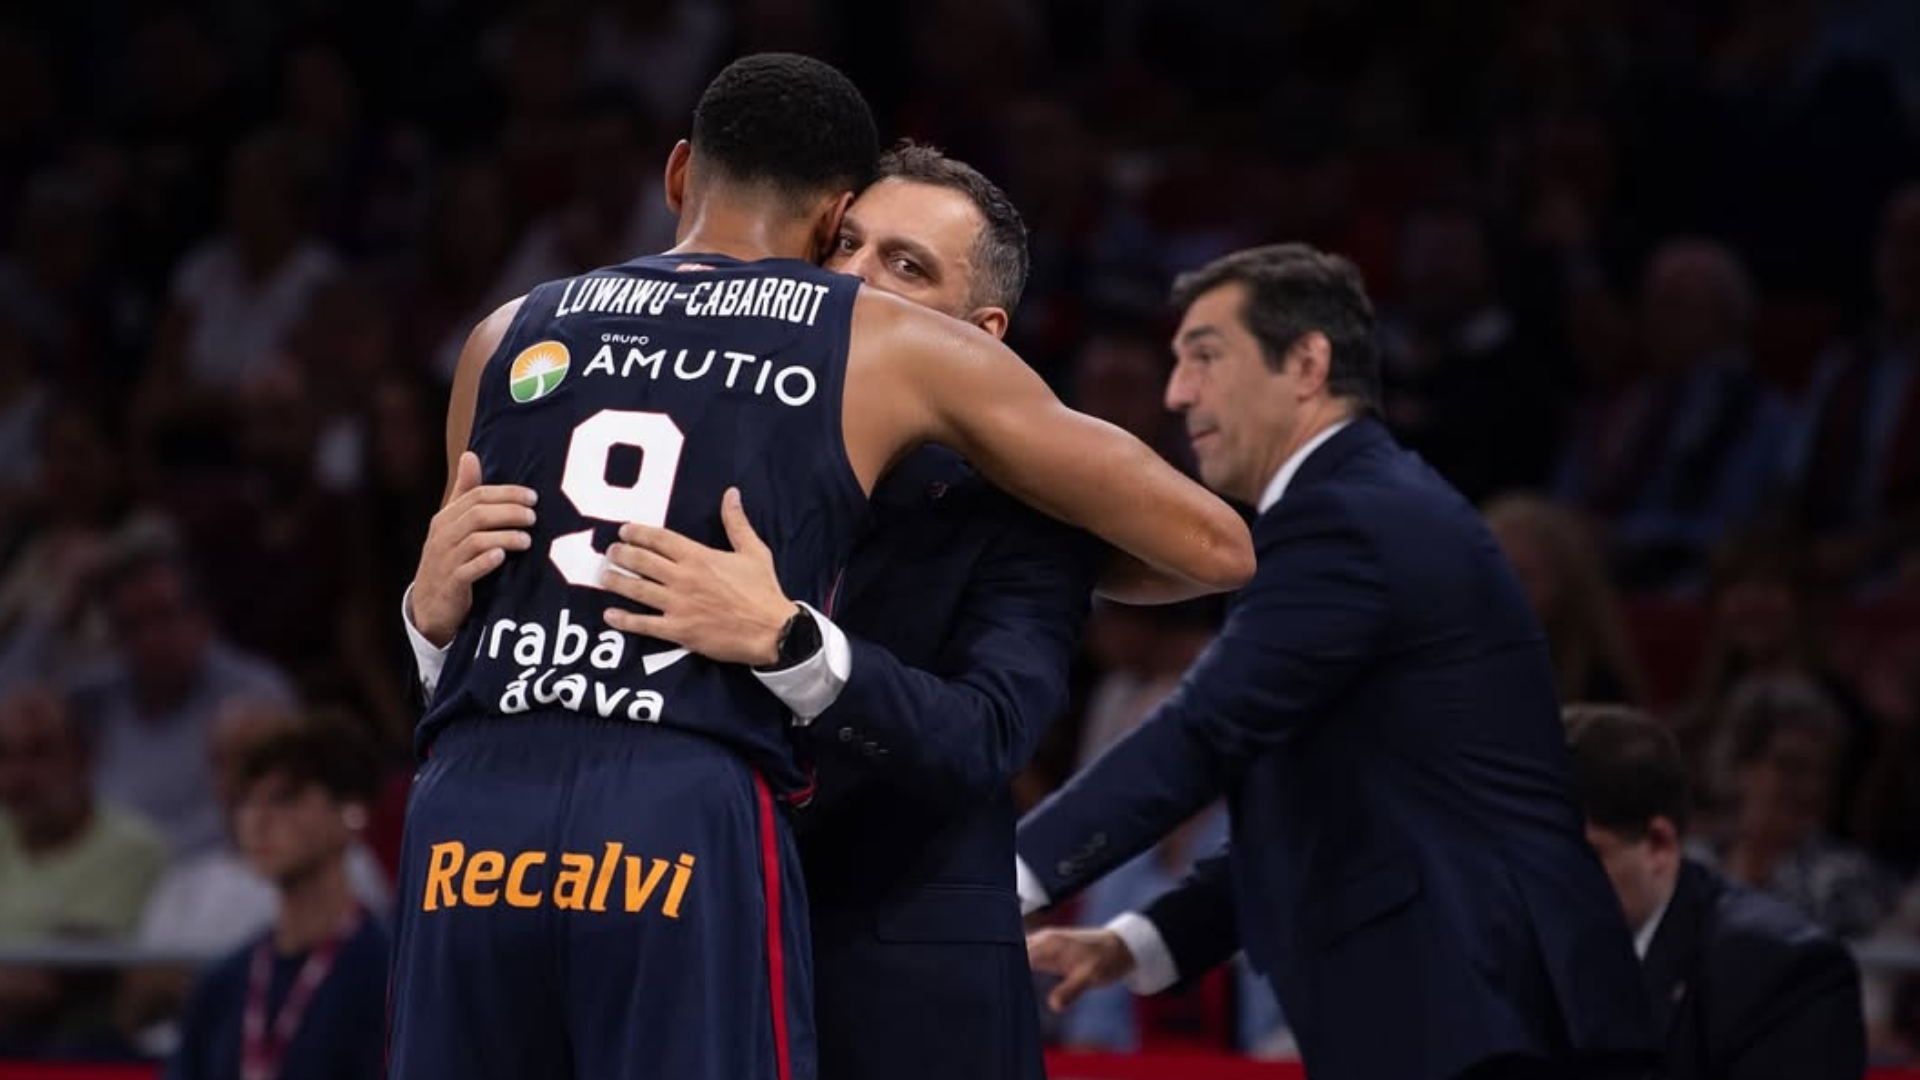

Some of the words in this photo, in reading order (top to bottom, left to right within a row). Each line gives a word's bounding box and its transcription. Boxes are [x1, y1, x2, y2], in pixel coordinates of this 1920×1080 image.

[556, 278, 829, 326] LUWAWU-CABARROT
[601, 333, 650, 345] GRUPO
[583, 345, 816, 406] AMUTIO
[549, 408, 685, 590] 9
[475, 609, 625, 669] raba
[423, 841, 696, 917] Recalvi
